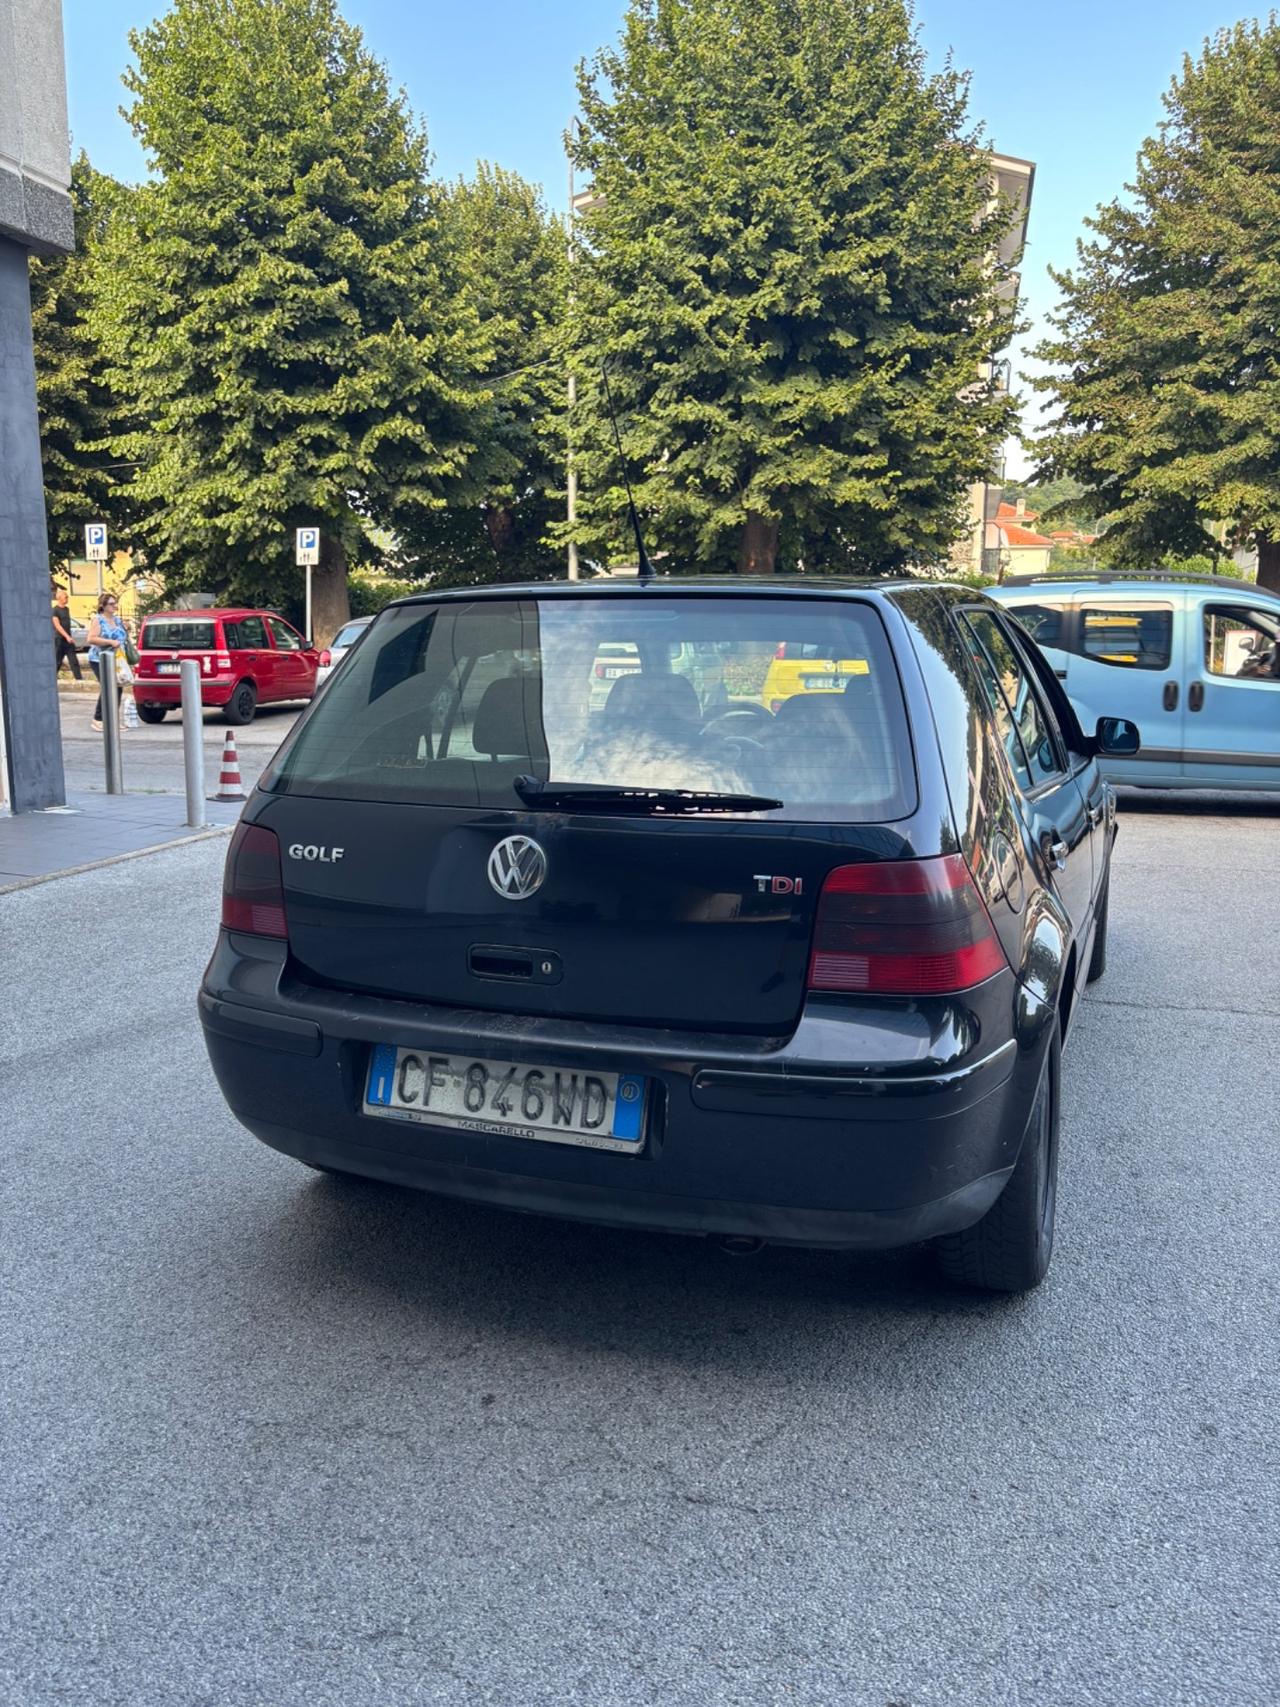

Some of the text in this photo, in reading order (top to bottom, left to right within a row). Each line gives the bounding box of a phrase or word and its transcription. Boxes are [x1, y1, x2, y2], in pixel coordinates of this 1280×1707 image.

[90, 528, 102, 544] P
[302, 532, 314, 548] P
[289, 843, 345, 863] GOLF
[753, 875, 803, 895] TDI
[457, 1120, 535, 1138] MASCARELLO
